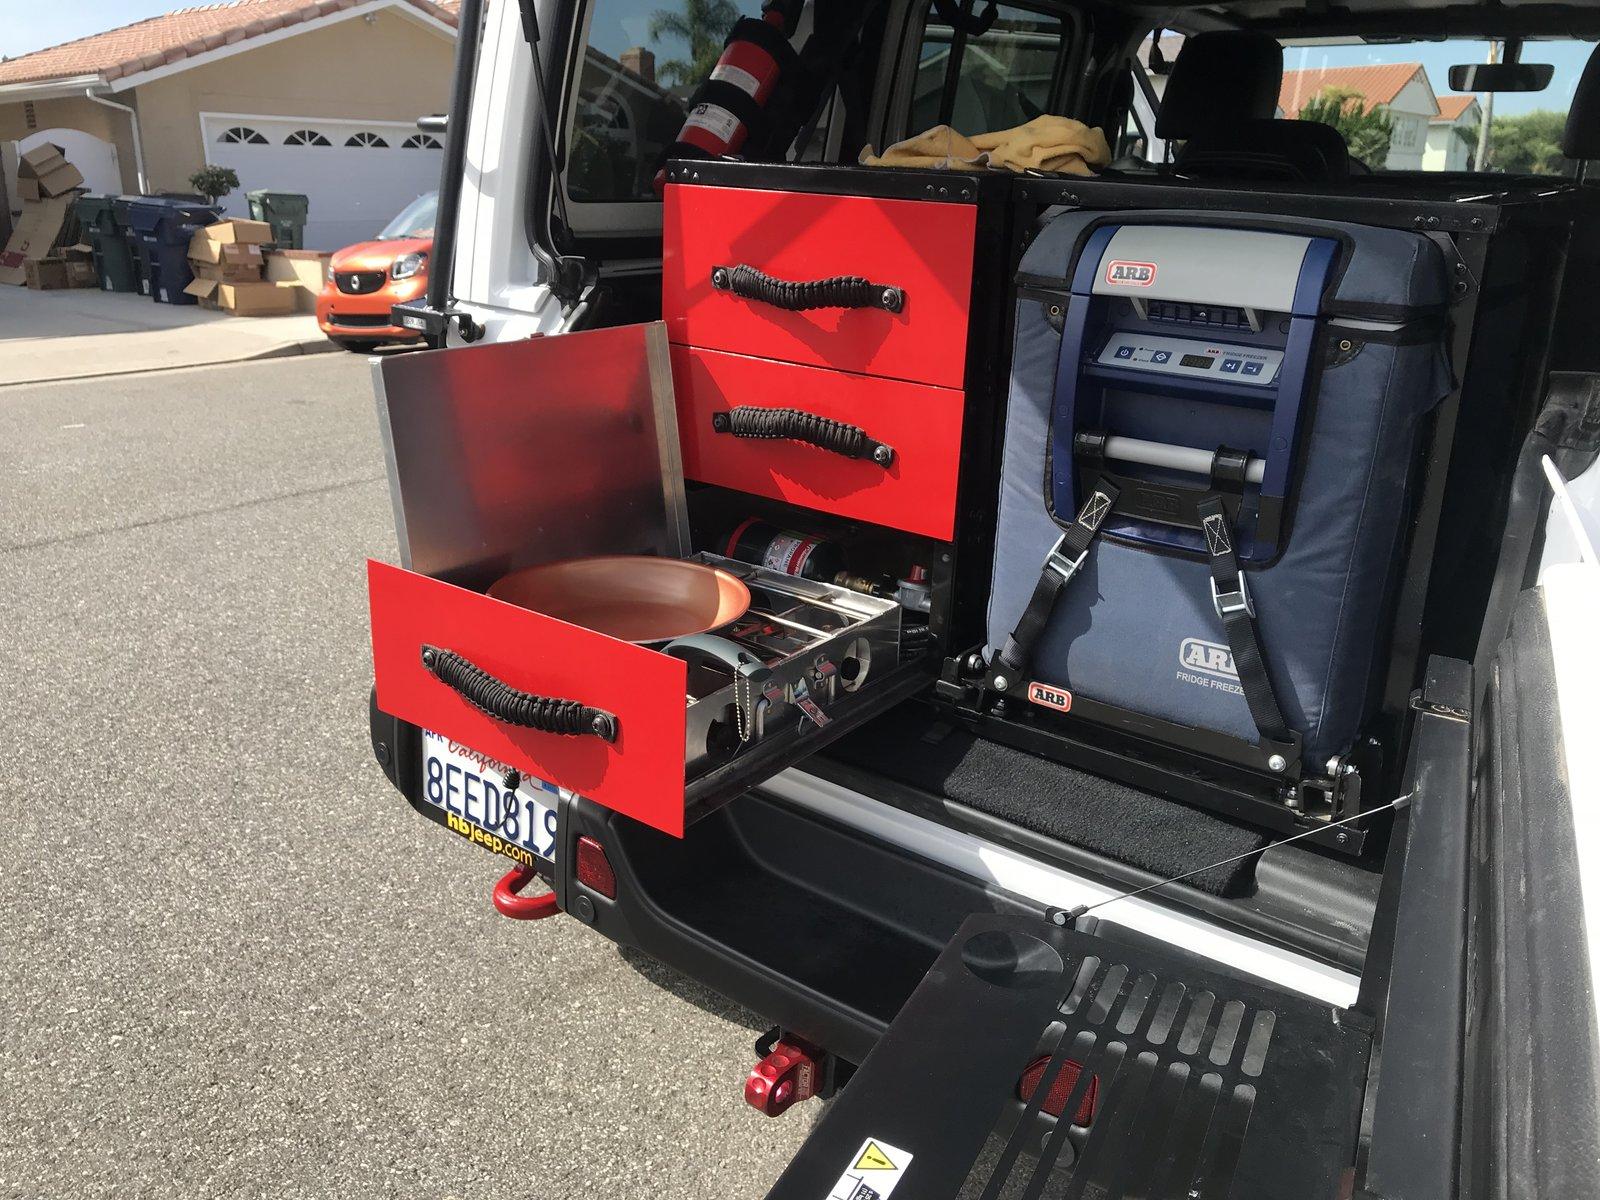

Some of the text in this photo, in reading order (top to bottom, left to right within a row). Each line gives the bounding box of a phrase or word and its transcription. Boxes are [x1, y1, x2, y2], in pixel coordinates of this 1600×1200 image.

[1112, 266, 1150, 281] ARB
[1186, 644, 1238, 673] AR
[1176, 671, 1245, 696] FRIDGE FREEZE
[1034, 688, 1065, 706] ARB
[427, 756, 556, 858] 8EED819
